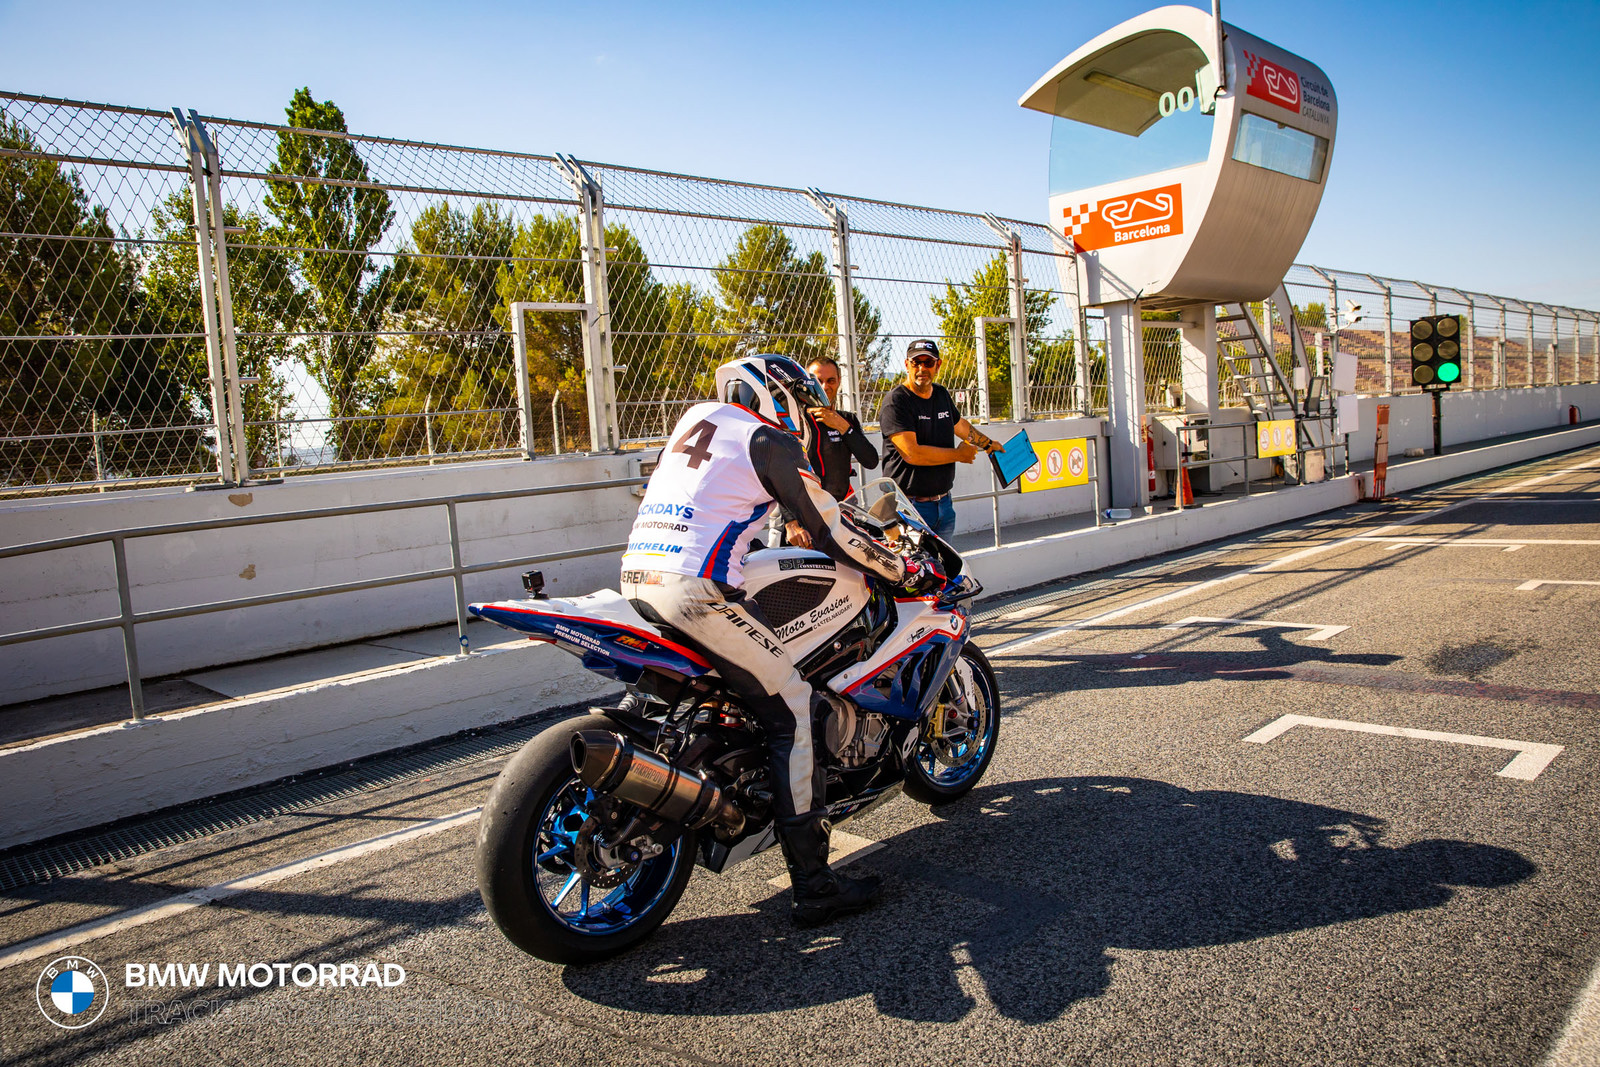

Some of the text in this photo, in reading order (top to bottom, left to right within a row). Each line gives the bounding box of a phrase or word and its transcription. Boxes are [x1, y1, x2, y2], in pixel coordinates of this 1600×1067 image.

[1300, 76, 1329, 97] Circuit de
[1159, 86, 1195, 117] 00
[1303, 90, 1330, 112] Barcelona
[1302, 105, 1329, 124] CATALUNYA
[1114, 223, 1171, 243] Barcelona
[671, 418, 718, 470] 4
[641, 521, 688, 532] MOTORRAD
[628, 542, 683, 553] MICHELIN
[776, 595, 851, 640] Moto Evasion
[813, 603, 853, 630] CASTELNAUDARY
[555, 624, 601, 646] BMW MOTORRAD
[706, 602, 784, 658] DAINESE
[553, 629, 581, 644] PREMIUM
[580, 640, 611, 657] SELECTION
